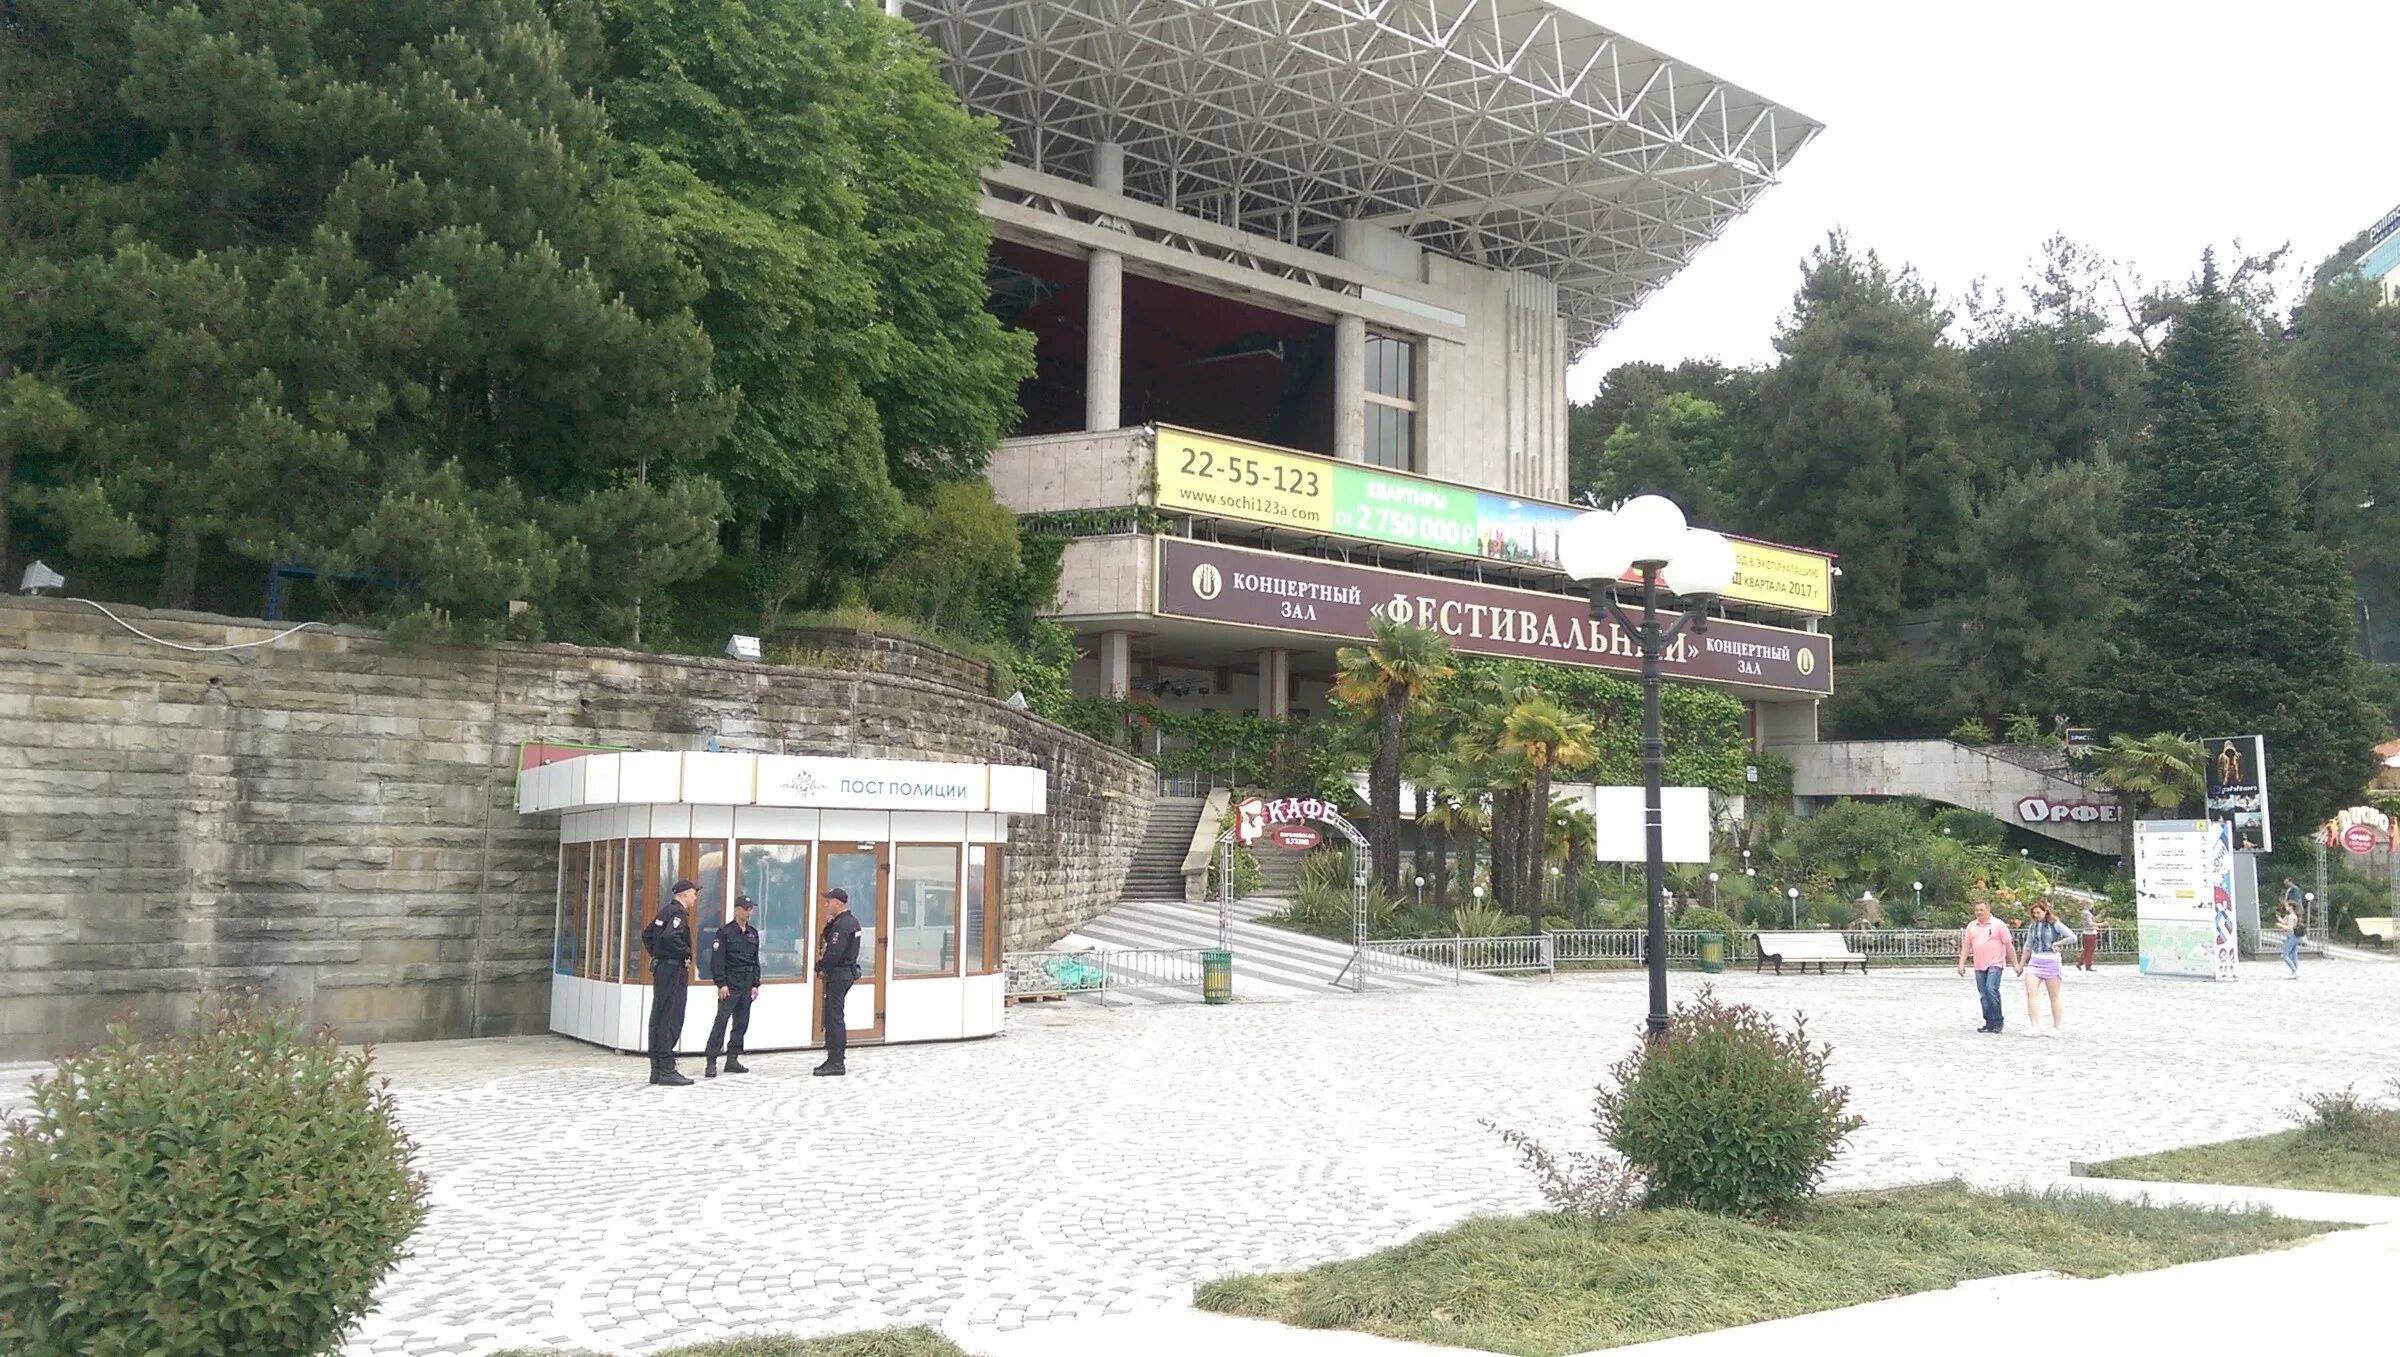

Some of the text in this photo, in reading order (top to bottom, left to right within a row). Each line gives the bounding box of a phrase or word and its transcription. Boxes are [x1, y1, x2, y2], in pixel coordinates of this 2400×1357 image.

[1180, 447, 1319, 498] 22-55-123
[1179, 487, 1320, 522] www.sochi123a.com
[1367, 481, 1447, 510] КВАРТИРЫ
[1356, 503, 1371, 532] 2
[1376, 507, 1416, 539] 750
[1420, 515, 1460, 546] 000
[1735, 554, 1748, 567] ОД
[1756, 558, 1820, 579] ЭКСПЛУАТАЦИЮ
[1233, 572, 1361, 606] КОНЦЕРТНЫЙ
[1744, 576, 1787, 593] КВАРТАЛА
[1789, 582, 1812, 598] 2017
[1280, 600, 1317, 621] ЗАЛ
[1706, 637, 1790, 662] КОНЦЕРТНЫЙ
[1737, 659, 1762, 676] ЗАЛ
[841, 778, 967, 799] ПОСТ ПОЛИЦИИ
[1265, 797, 1338, 825] КАФЕ
[2019, 799, 2122, 821] ОРФЕ
